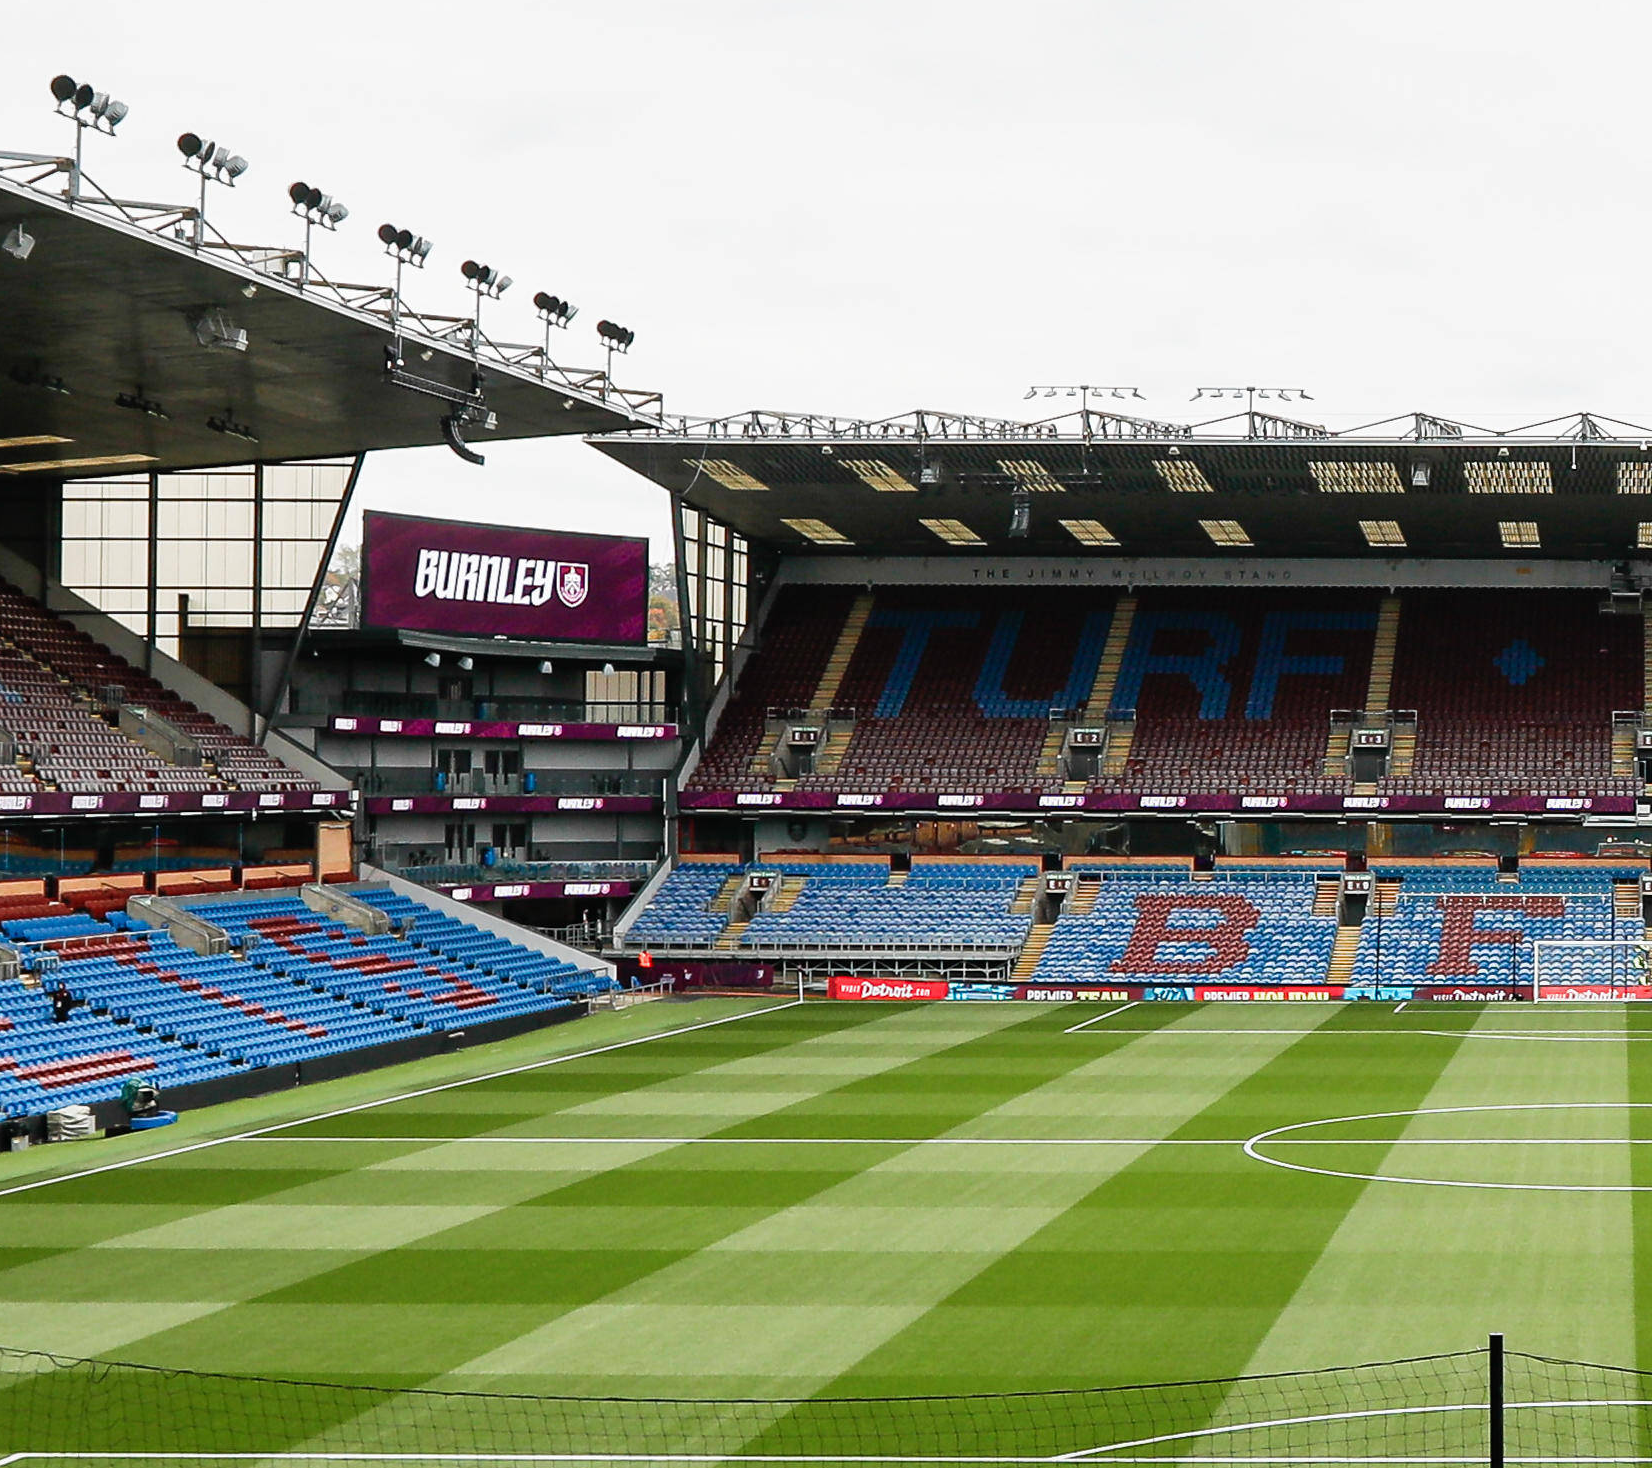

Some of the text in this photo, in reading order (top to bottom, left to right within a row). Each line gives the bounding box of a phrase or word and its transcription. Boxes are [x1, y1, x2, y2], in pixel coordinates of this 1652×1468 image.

[414, 548, 556, 606] BURNLEY
[973, 568, 1010, 579] THE
[1026, 568, 1095, 579] JIMMY
[1111, 569, 1206, 580] McILROY
